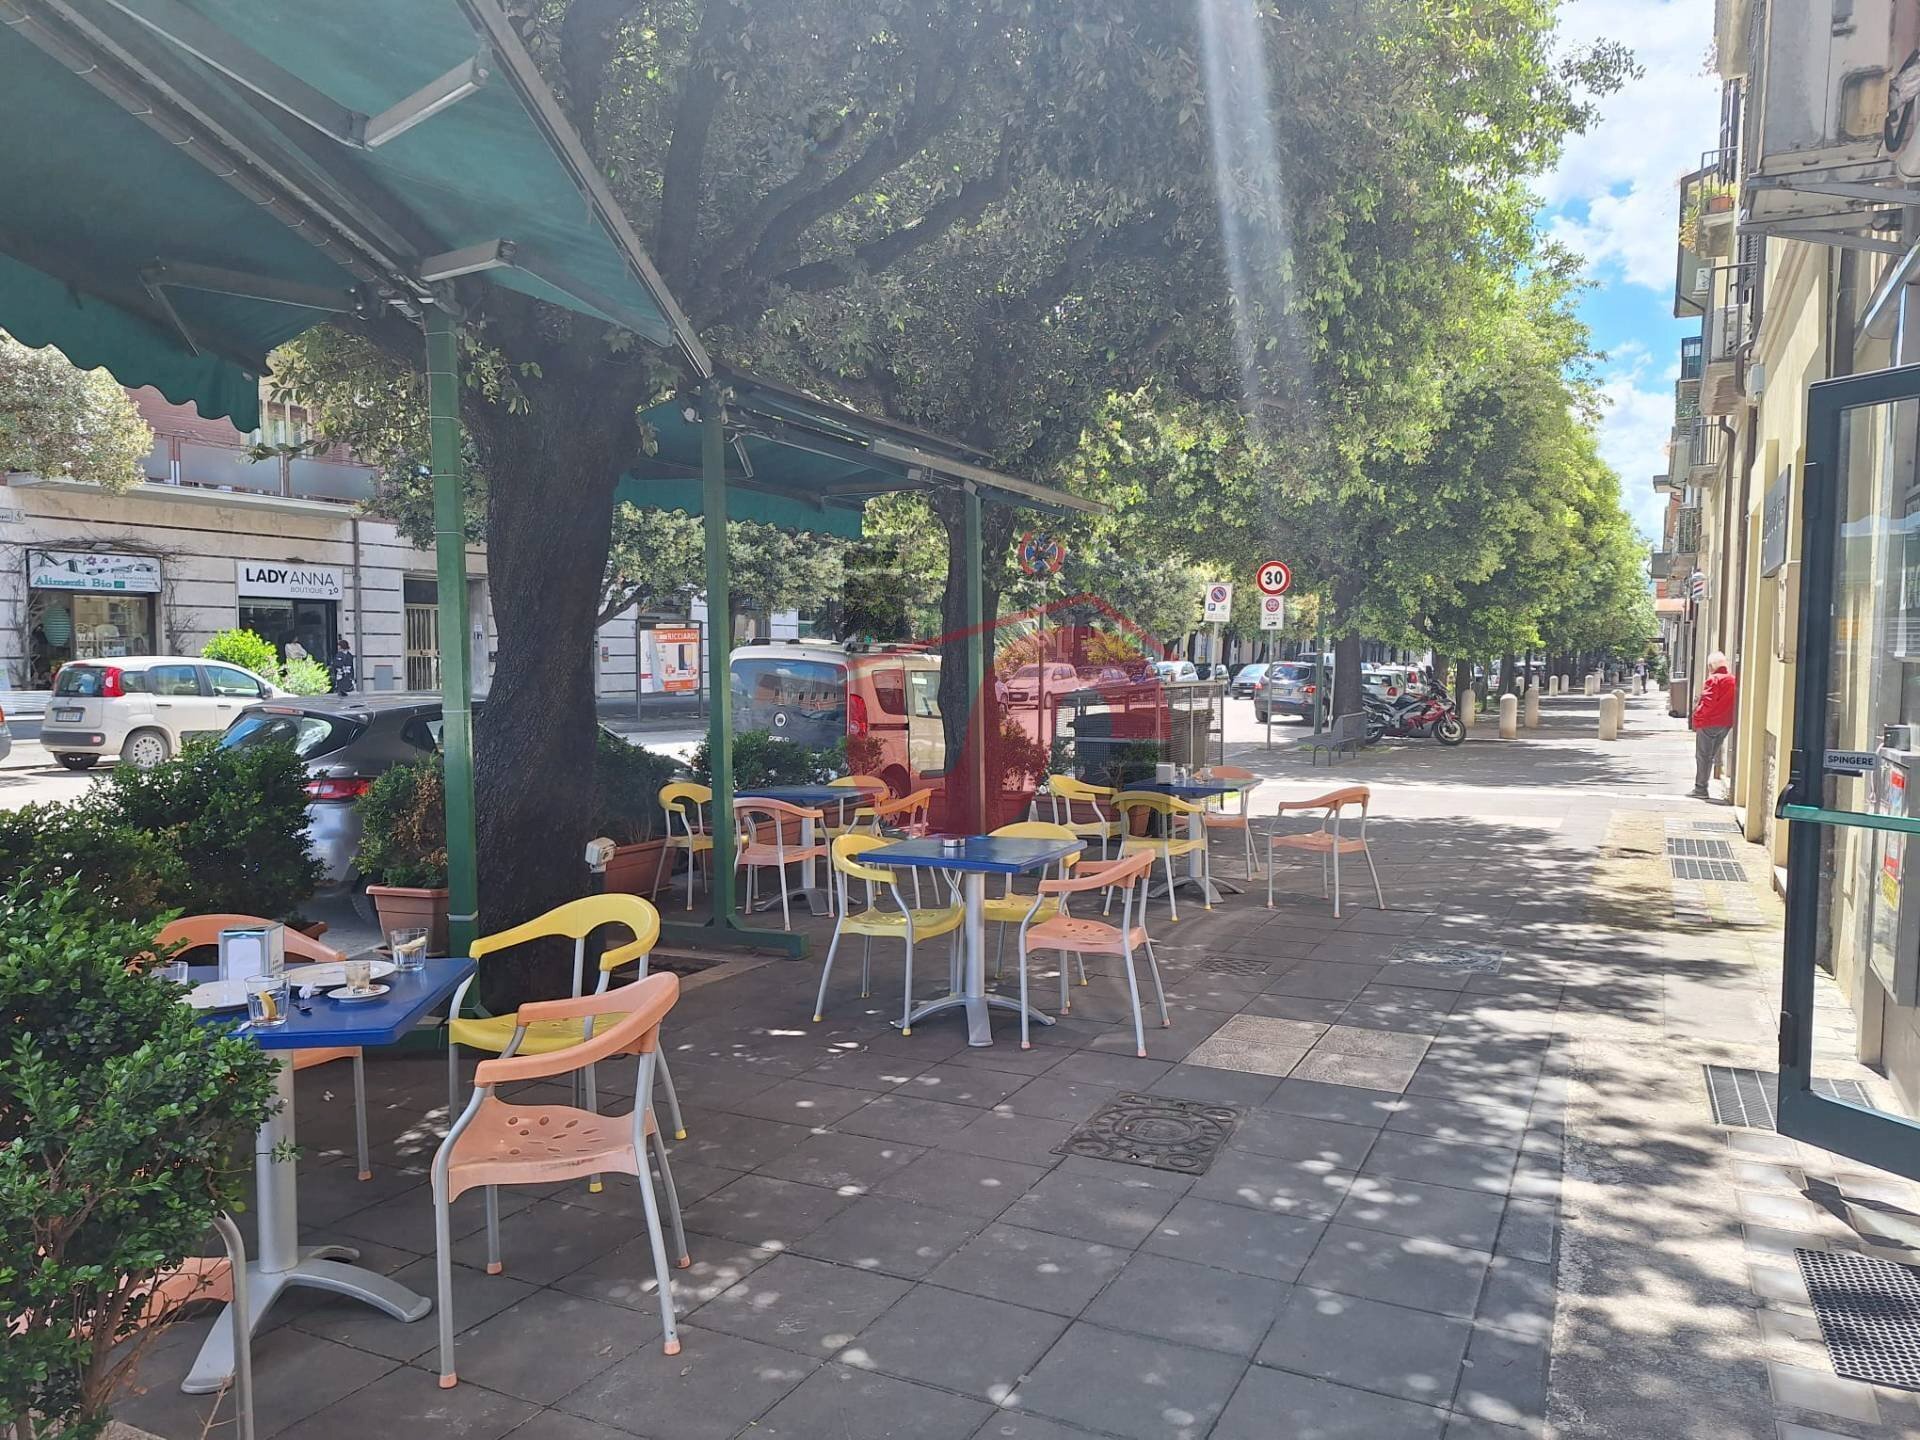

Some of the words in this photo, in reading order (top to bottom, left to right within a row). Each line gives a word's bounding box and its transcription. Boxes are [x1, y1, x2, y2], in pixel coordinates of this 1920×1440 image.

[34, 575, 86, 587] Alimenti
[92, 578, 112, 588] Bio
[246, 568, 288, 584] LADY
[290, 571, 335, 587] ANNA
[1265, 571, 1283, 585] 30
[1828, 755, 1873, 765] SPINGERE
